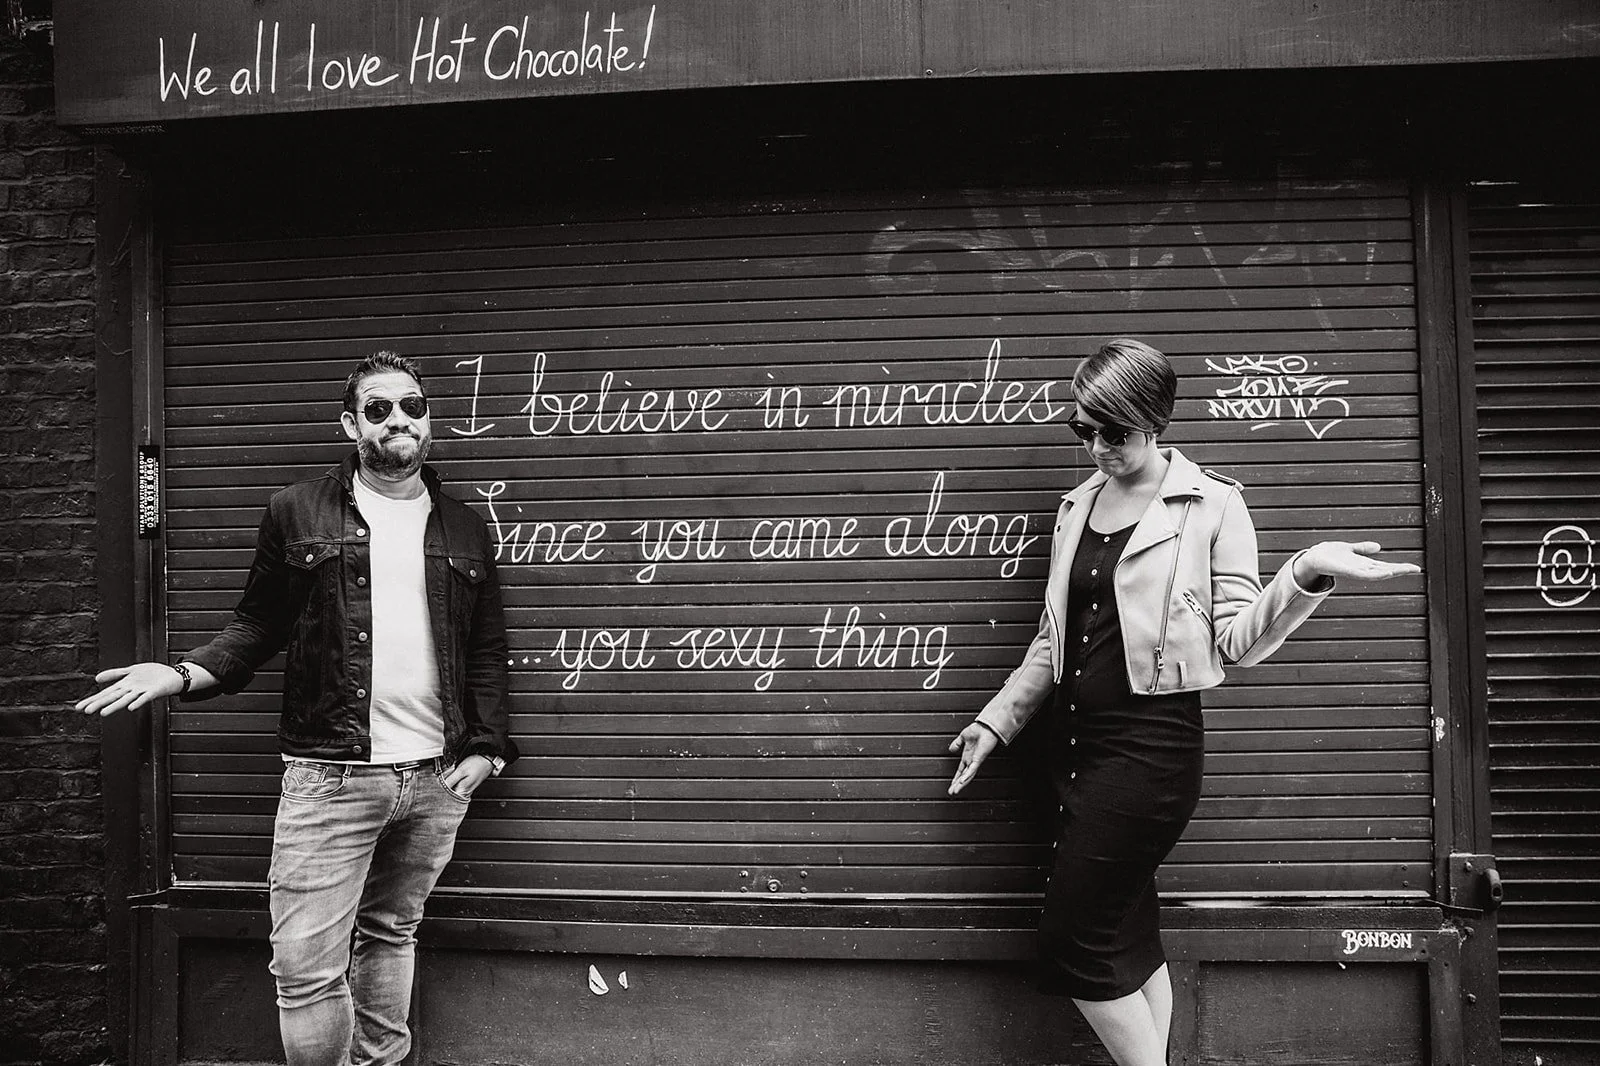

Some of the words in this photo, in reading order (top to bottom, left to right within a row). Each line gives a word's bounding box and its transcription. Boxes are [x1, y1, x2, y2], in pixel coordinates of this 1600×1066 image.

[160, 33, 217, 101] We
[230, 20, 279, 94] all
[307, 23, 399, 91] love
[410, 17, 477, 84] Hot
[484, 5, 656, 80] Chocolate!
[451, 356, 495, 435] I
[521, 353, 729, 436] believe
[755, 372, 809, 429] in
[823, 338, 1066, 428] miracles
[146, 505, 154, 528] 0333
[476, 481, 606, 564] Since
[631, 520, 726, 583] you
[749, 518, 860, 560] came
[885, 471, 1039, 578] along
[669, 627, 786, 691] sexy
[809, 606, 955, 690] thing
[1341, 929, 1412, 955] BONBON
